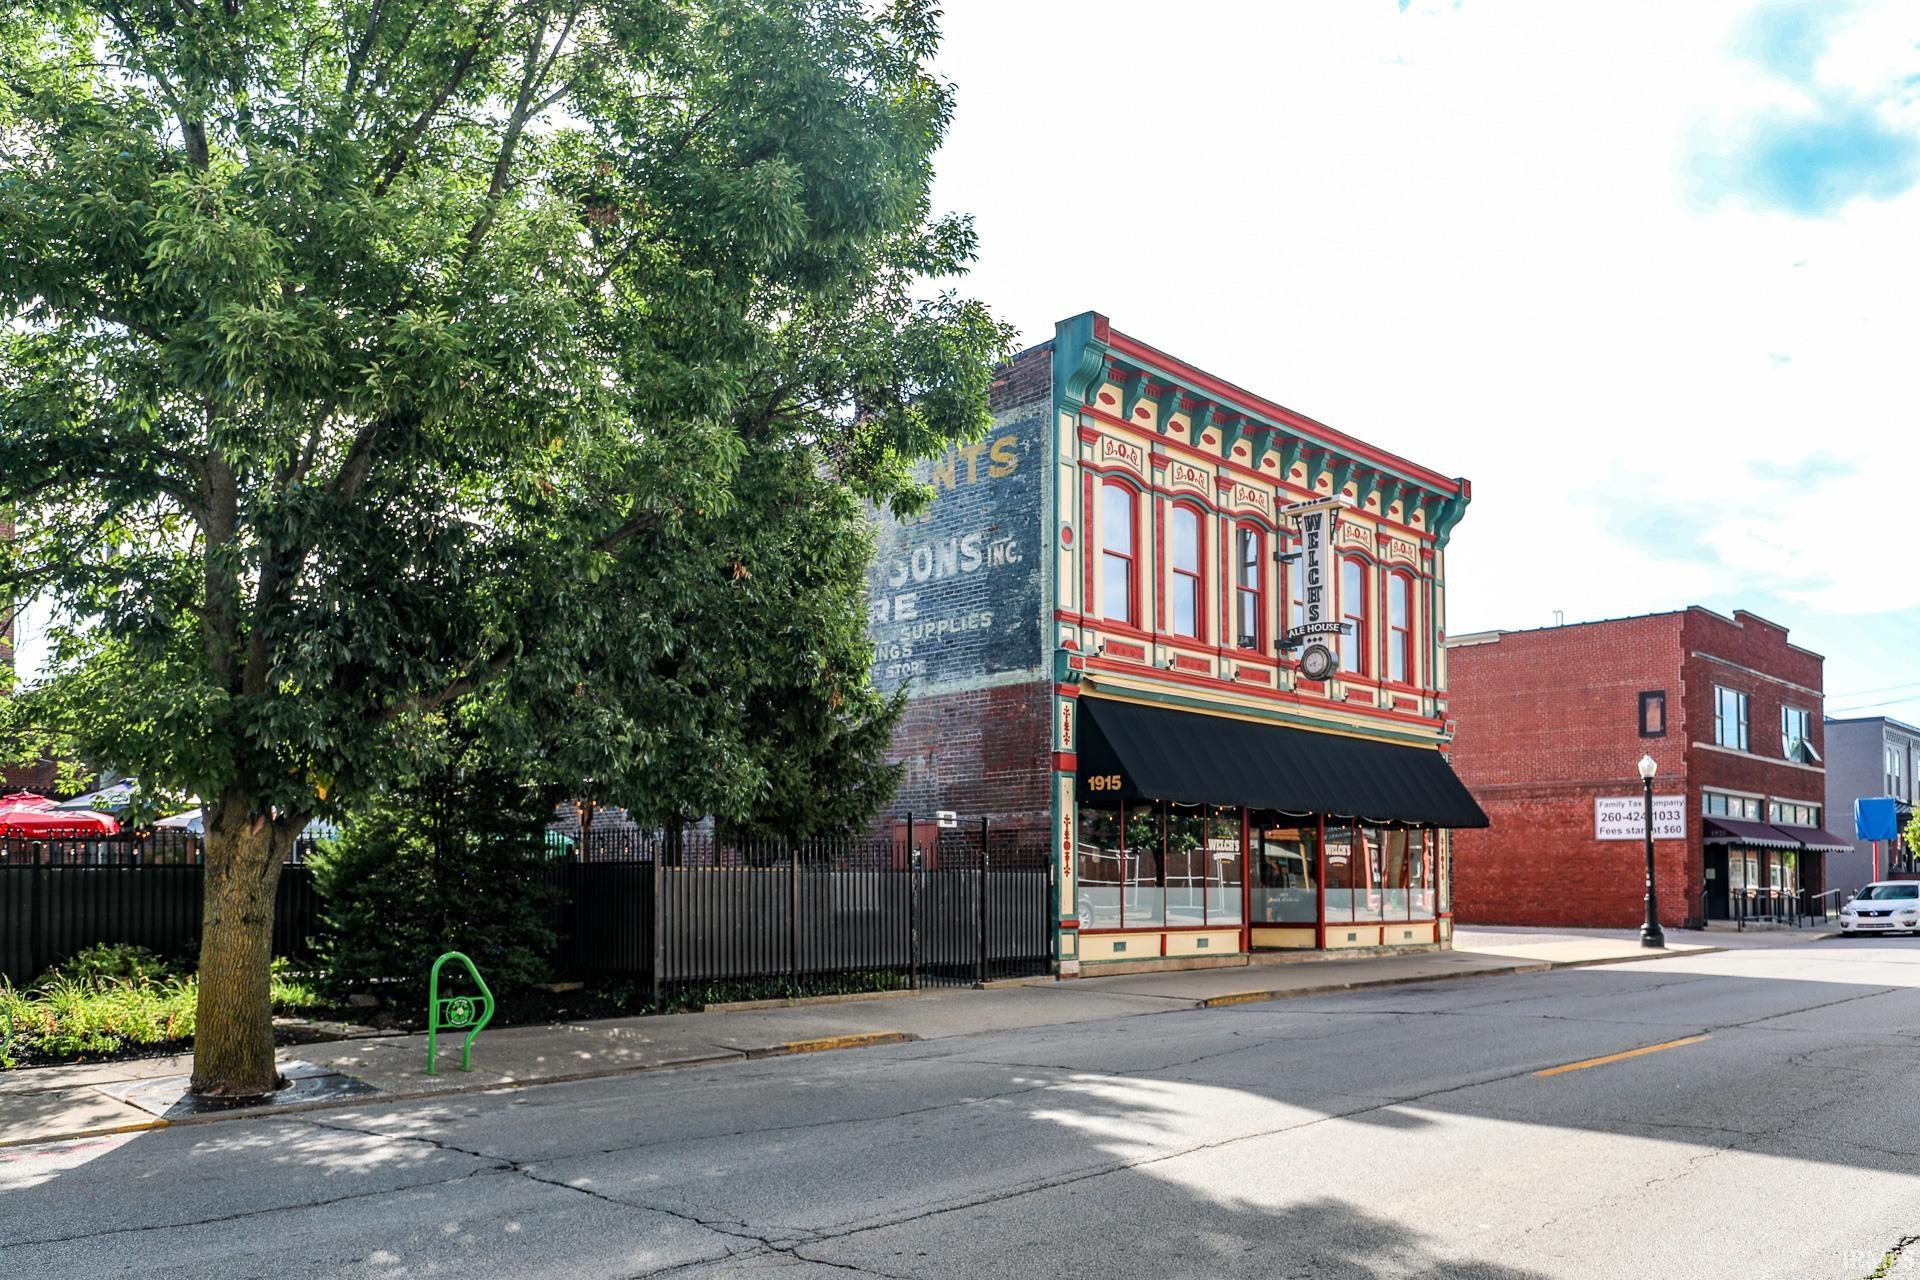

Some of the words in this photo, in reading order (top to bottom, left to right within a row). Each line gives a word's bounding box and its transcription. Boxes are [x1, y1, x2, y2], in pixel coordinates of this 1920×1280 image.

[932, 435, 1019, 491] NTS
[901, 611, 994, 641] SUPPLIES
[1288, 625, 1305, 638] ALE
[1306, 623, 1340, 633] HOUSE
[873, 641, 912, 662] INGS
[1088, 775, 1121, 791] 1915
[1599, 801, 1625, 809] Family
[1601, 811, 1681, 822] 260-4241033
[1599, 827, 1623, 835] Fees
[1625, 827, 1646, 835] star
[1664, 825, 1682, 834] $60
